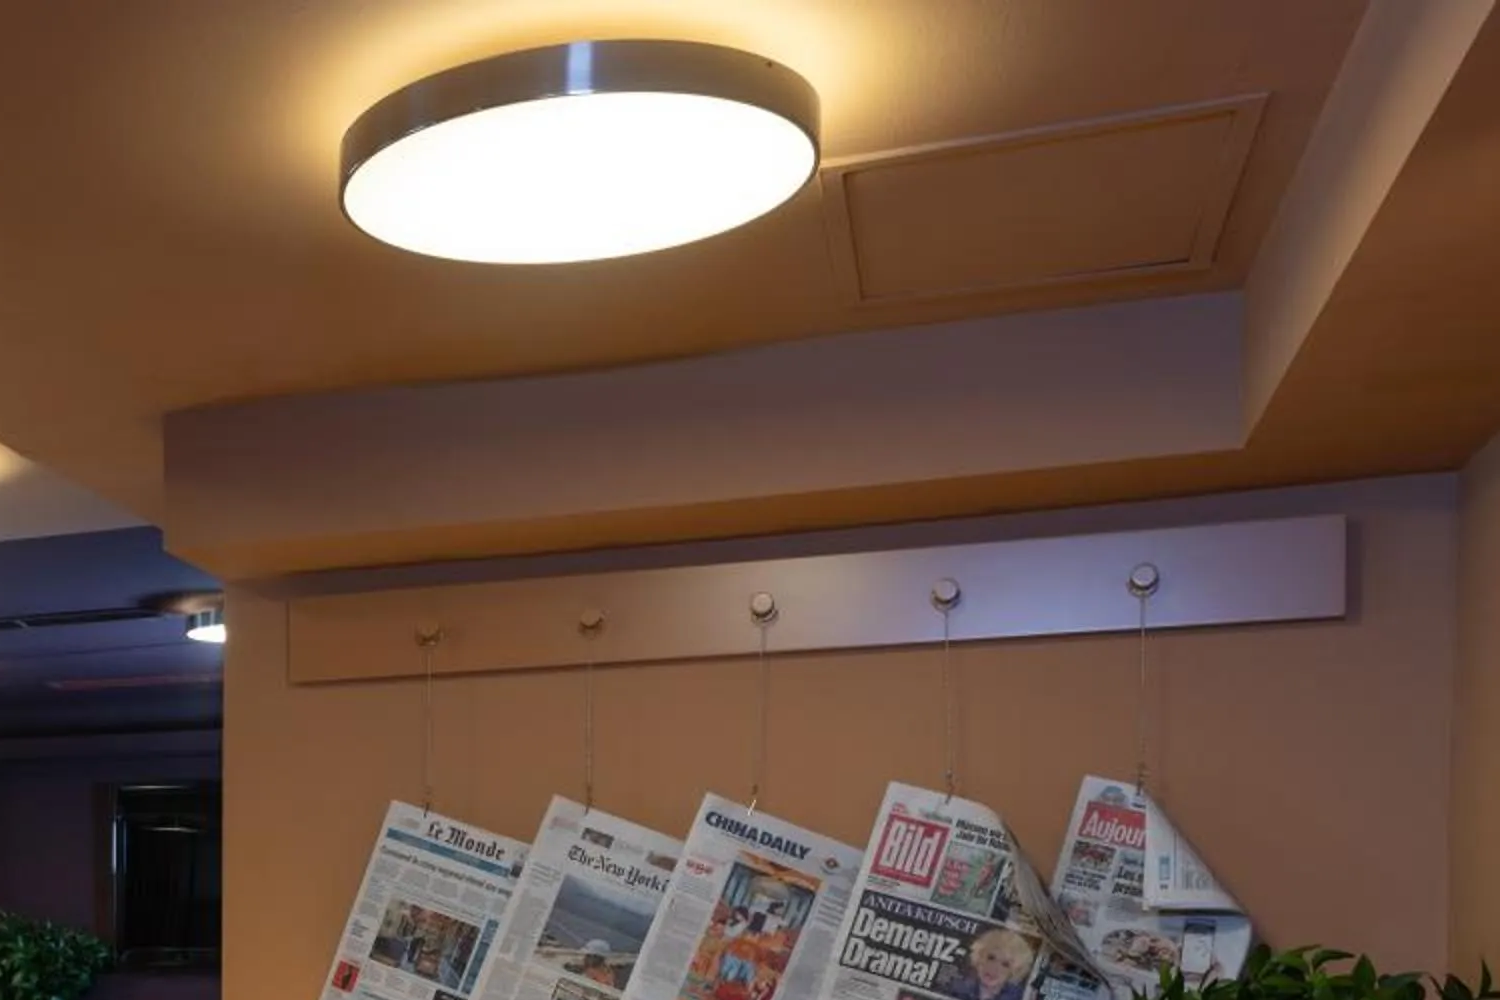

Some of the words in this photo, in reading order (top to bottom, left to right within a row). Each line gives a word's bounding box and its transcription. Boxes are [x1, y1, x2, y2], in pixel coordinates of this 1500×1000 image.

[426, 820, 443, 841] Le
[445, 826, 505, 860] Monde
[705, 811, 758, 842] CHINA
[759, 831, 812, 860] DAILY
[568, 844, 594, 867] The
[593, 854, 626, 877] New
[624, 865, 662, 891] York
[852, 907, 967, 963] Demenz-
[863, 894, 913, 917] ANITA
[914, 905, 980, 934] KUPSCH
[842, 937, 940, 988] Drama!
